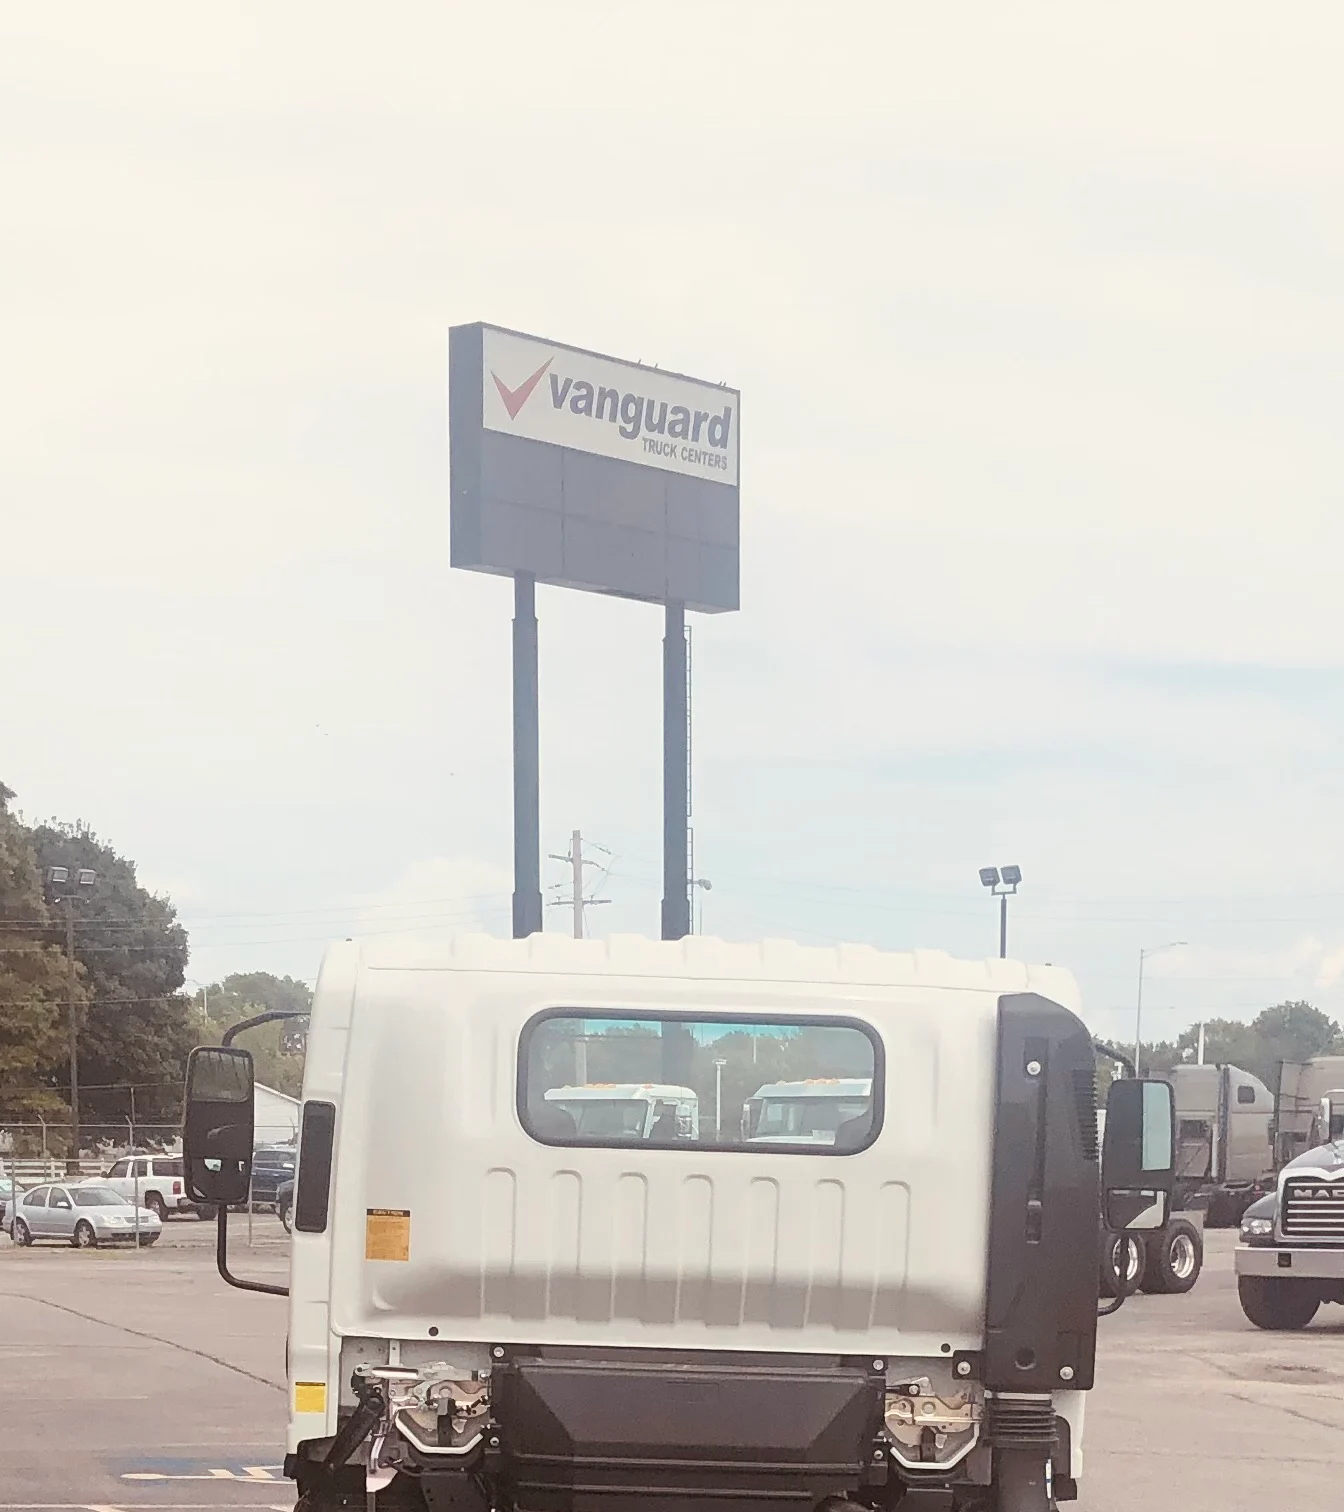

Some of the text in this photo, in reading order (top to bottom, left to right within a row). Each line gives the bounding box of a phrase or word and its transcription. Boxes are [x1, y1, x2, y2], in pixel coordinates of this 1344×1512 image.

[549, 372, 733, 450] vanguard
[642, 436, 728, 471] TRUCK CENTERS
